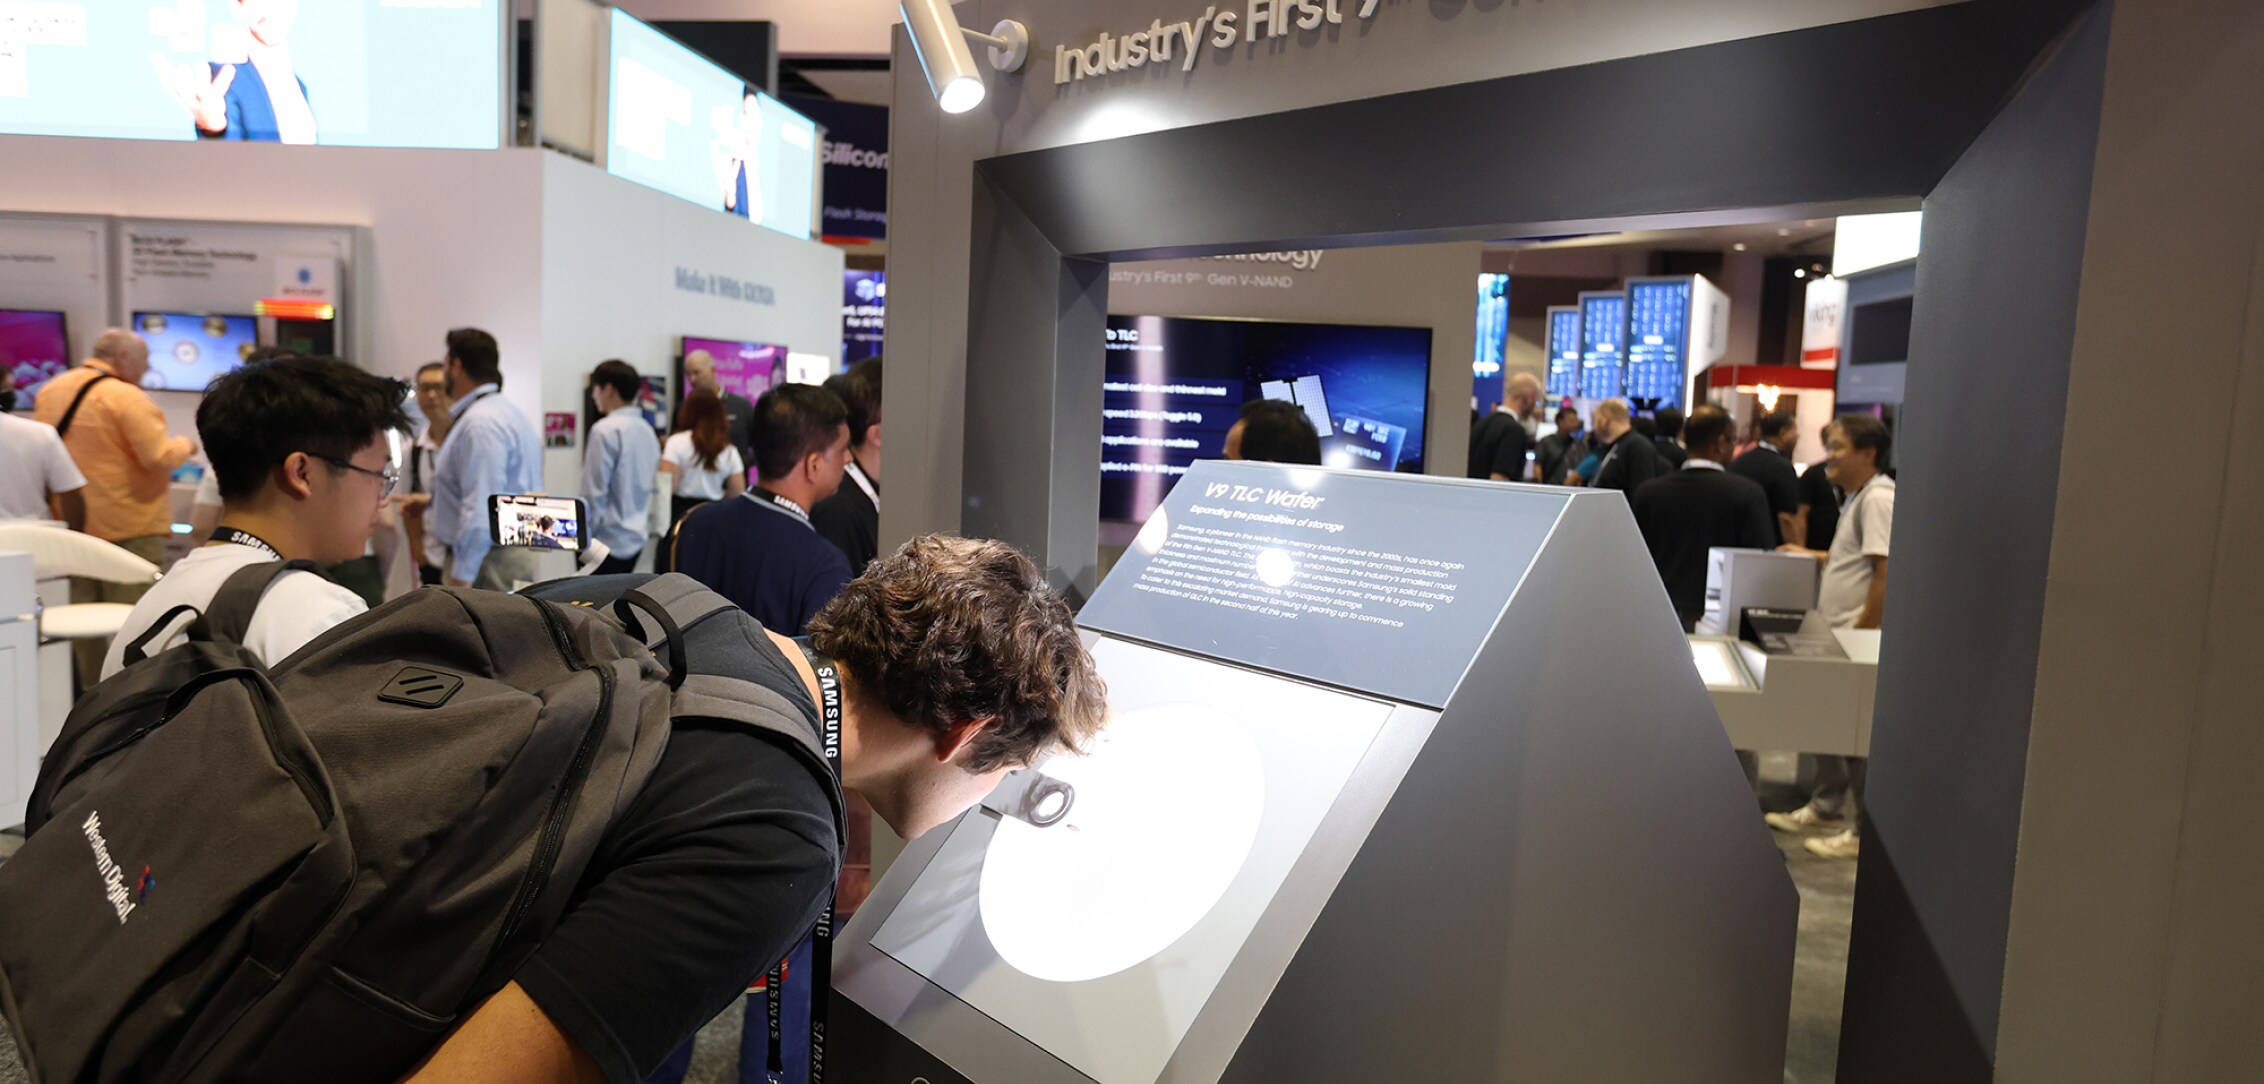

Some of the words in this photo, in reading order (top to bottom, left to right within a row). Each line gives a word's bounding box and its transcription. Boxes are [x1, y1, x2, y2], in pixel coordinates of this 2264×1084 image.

[1054, 5, 1237, 84] Industry's
[1246, 0, 1342, 42] First
[1154, 272, 1182, 284] First
[1208, 273, 1236, 285] Gen
[1239, 275, 1293, 289] V-NAND
[1118, 330, 1138, 341] TLC
[1165, 439, 1199, 448] available
[1205, 481, 1229, 498] V9
[1229, 485, 1264, 503] TLC
[1265, 489, 1326, 510] Wafer
[1189, 504, 1231, 520] Expanding
[1232, 508, 1247, 518] the
[1246, 510, 1296, 527] possibilities
[1297, 517, 1310, 527] of
[1307, 519, 1344, 533] storage
[1176, 524, 1203, 534] Samsung,
[1287, 541, 1317, 550] memory
[1317, 544, 1346, 554] industry
[1198, 557, 1230, 565] maximum
[1311, 575, 1357, 586] underscores
[1356, 581, 1398, 593] Samsung's
[1417, 591, 1453, 603] standing
[1318, 554, 1367, 566] development
[1403, 568, 1448, 578] production
[1325, 566, 1350, 574] boasts
[1363, 572, 1400, 583] industry's
[1399, 578, 1434, 587] smallest
[1433, 583, 1457, 591] mold
[1213, 589, 1239, 597] market
[1269, 598, 1302, 610] Samsung
[1307, 606, 1337, 616] gearing
[1357, 615, 1404, 627] commence
[1220, 600, 1246, 608] second
[1282, 590, 1332, 605] high-capacity
[1299, 583, 1336, 593] advances
[1363, 593, 1384, 601] there
[1398, 600, 1433, 611] growing
[818, 667, 838, 758] SAMSUNG
[82, 810, 113, 876] Western
[104, 864, 136, 920] Digital
